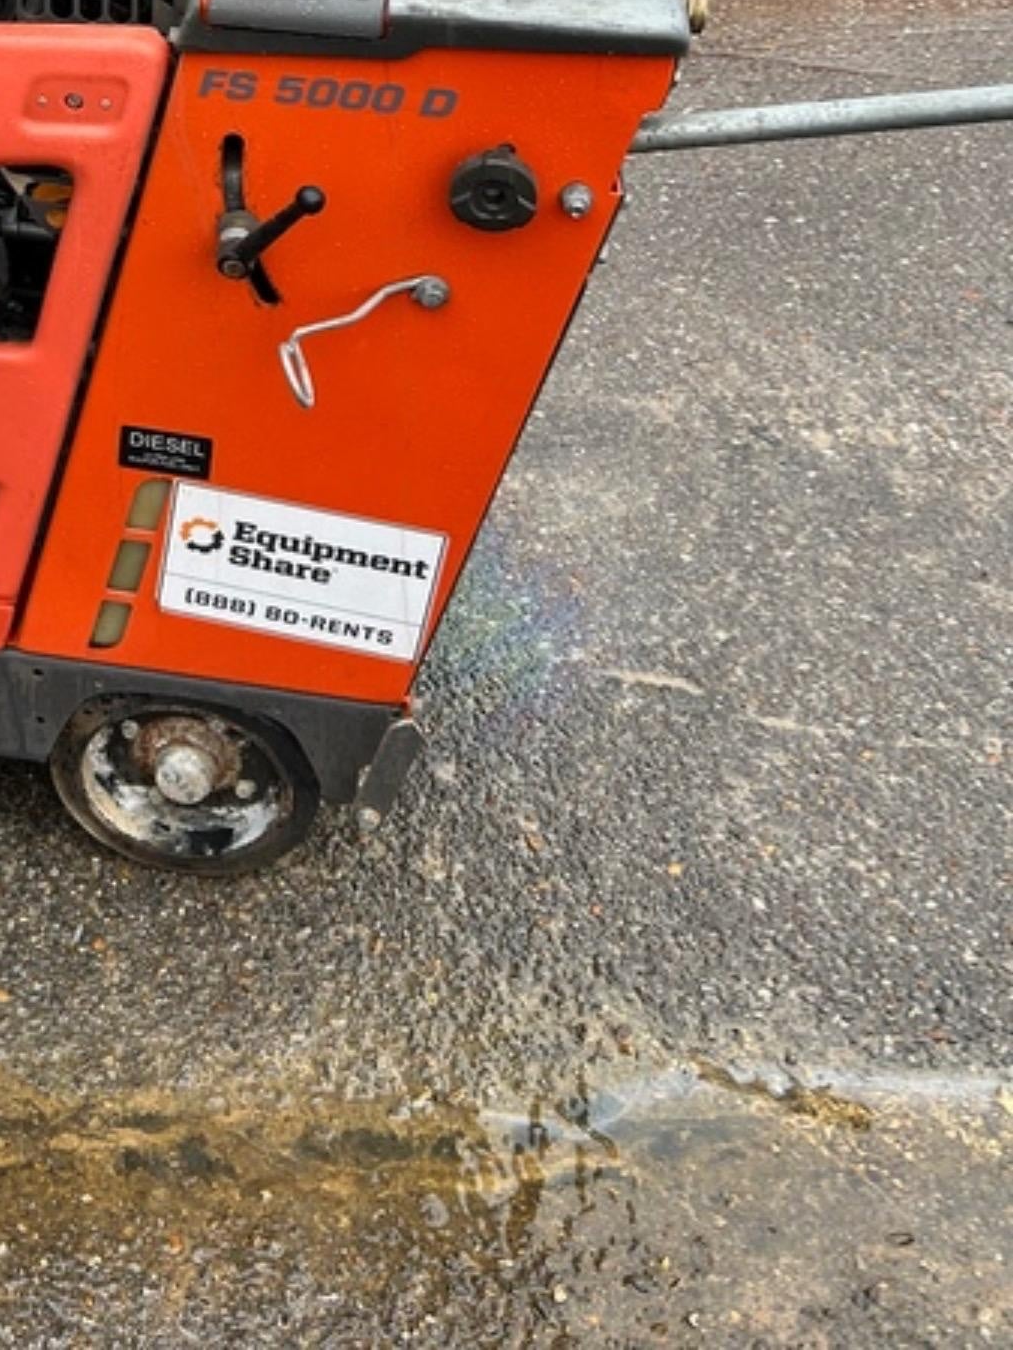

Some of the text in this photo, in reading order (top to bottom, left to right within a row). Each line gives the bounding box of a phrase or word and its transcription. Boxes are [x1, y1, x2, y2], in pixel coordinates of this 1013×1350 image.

[196, 70, 460, 118] FS 5000 D
[129, 431, 204, 456] DIESEL
[227, 546, 333, 585] Share
[233, 521, 429, 579] Equipment
[184, 587, 394, 646] (888) 80-RENTS
